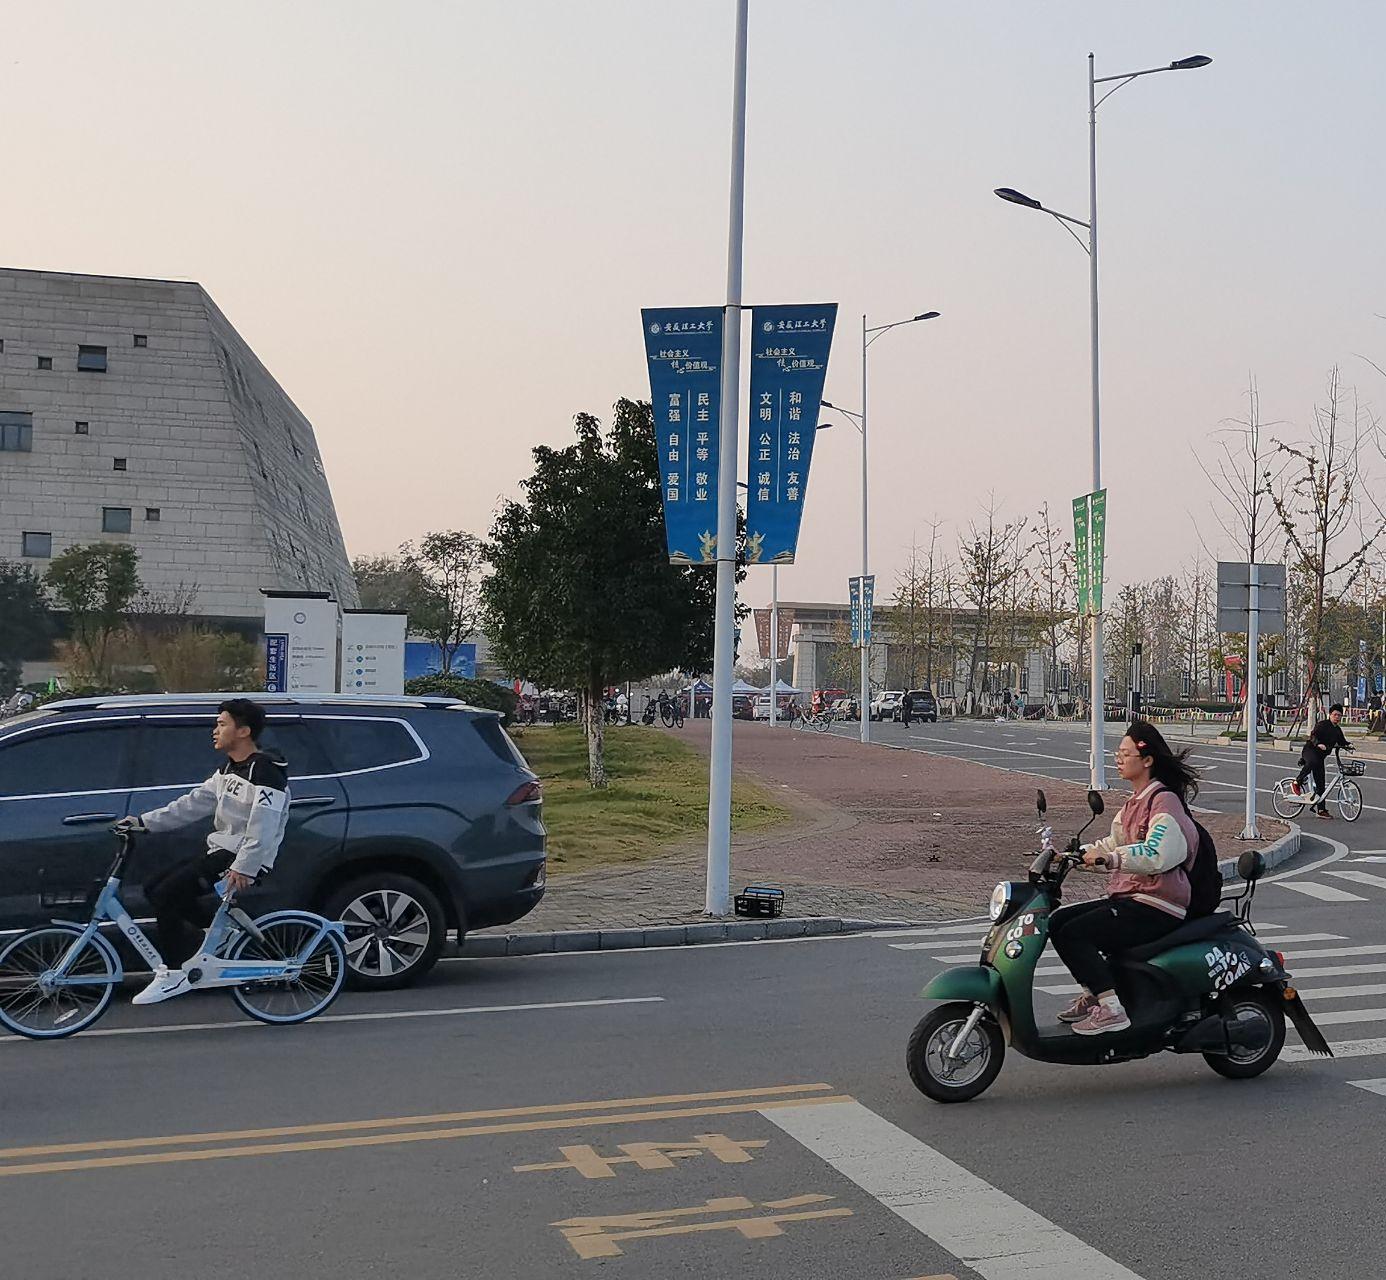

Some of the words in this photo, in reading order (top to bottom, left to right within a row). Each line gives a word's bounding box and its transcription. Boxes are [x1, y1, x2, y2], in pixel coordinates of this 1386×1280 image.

[659, 349, 690, 358] 社会主义
[765, 347, 796, 356] 社会主义
[668, 393, 681, 422] 富强
[696, 393, 709, 422] 民主
[759, 391, 772, 422] 文明
[788, 391, 802, 421] 和谐
[668, 433, 679, 462] 自由
[696, 432, 709, 462] 平等
[758, 432, 771, 462] 公正
[787, 432, 801, 461] 法治
[667, 472, 680, 501] 爱国
[695, 472, 708, 501] 敬业
[757, 472, 771, 501] 诚信
[786, 471, 800, 501] 友善
